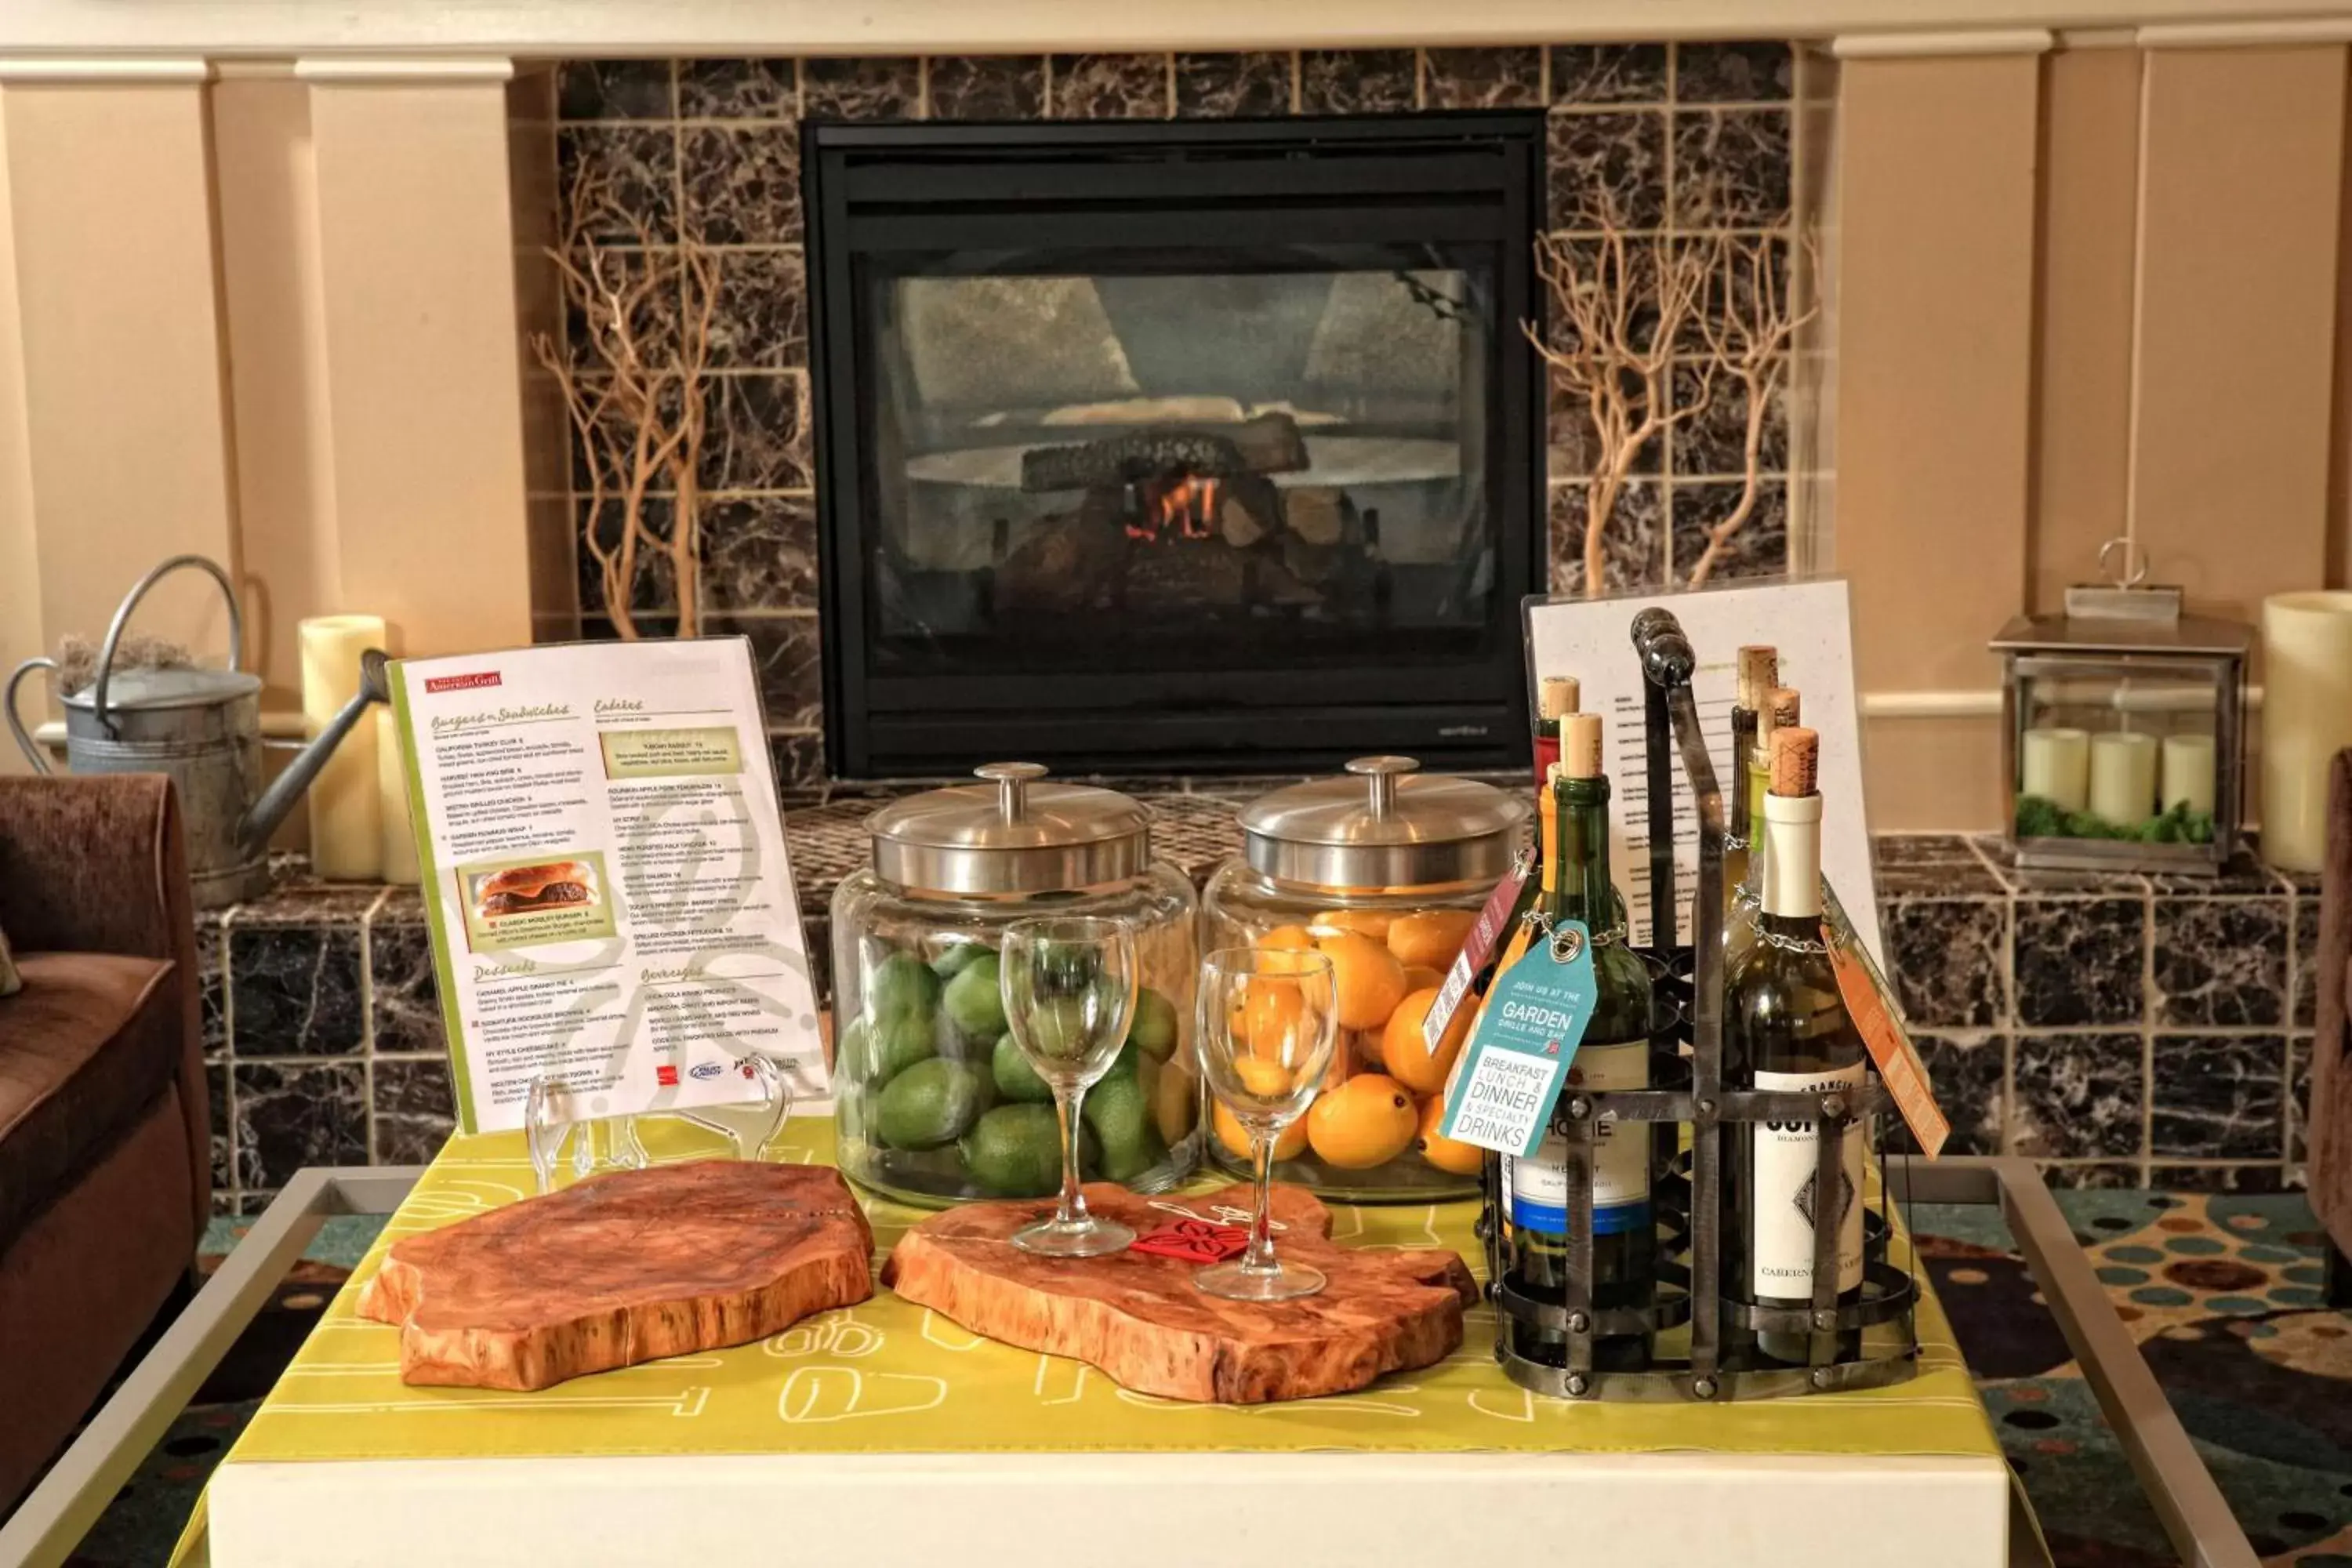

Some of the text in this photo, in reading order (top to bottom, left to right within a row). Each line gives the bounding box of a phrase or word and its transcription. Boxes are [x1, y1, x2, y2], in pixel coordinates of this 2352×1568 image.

[474, 673, 499, 687] Grill
[1512, 981, 1581, 1003] JOIN US AT THE
[1502, 1000, 1573, 1031] GARDEN
[1527, 1025, 1546, 1037] AND
[1483, 1055, 1550, 1081] BREAKFAST
[1478, 1069, 1544, 1094] LUNCH &
[1470, 1080, 1538, 1112] DINNER
[1474, 1102, 1531, 1125] SPECIALTY
[1457, 1113, 1526, 1148] DRINKS
